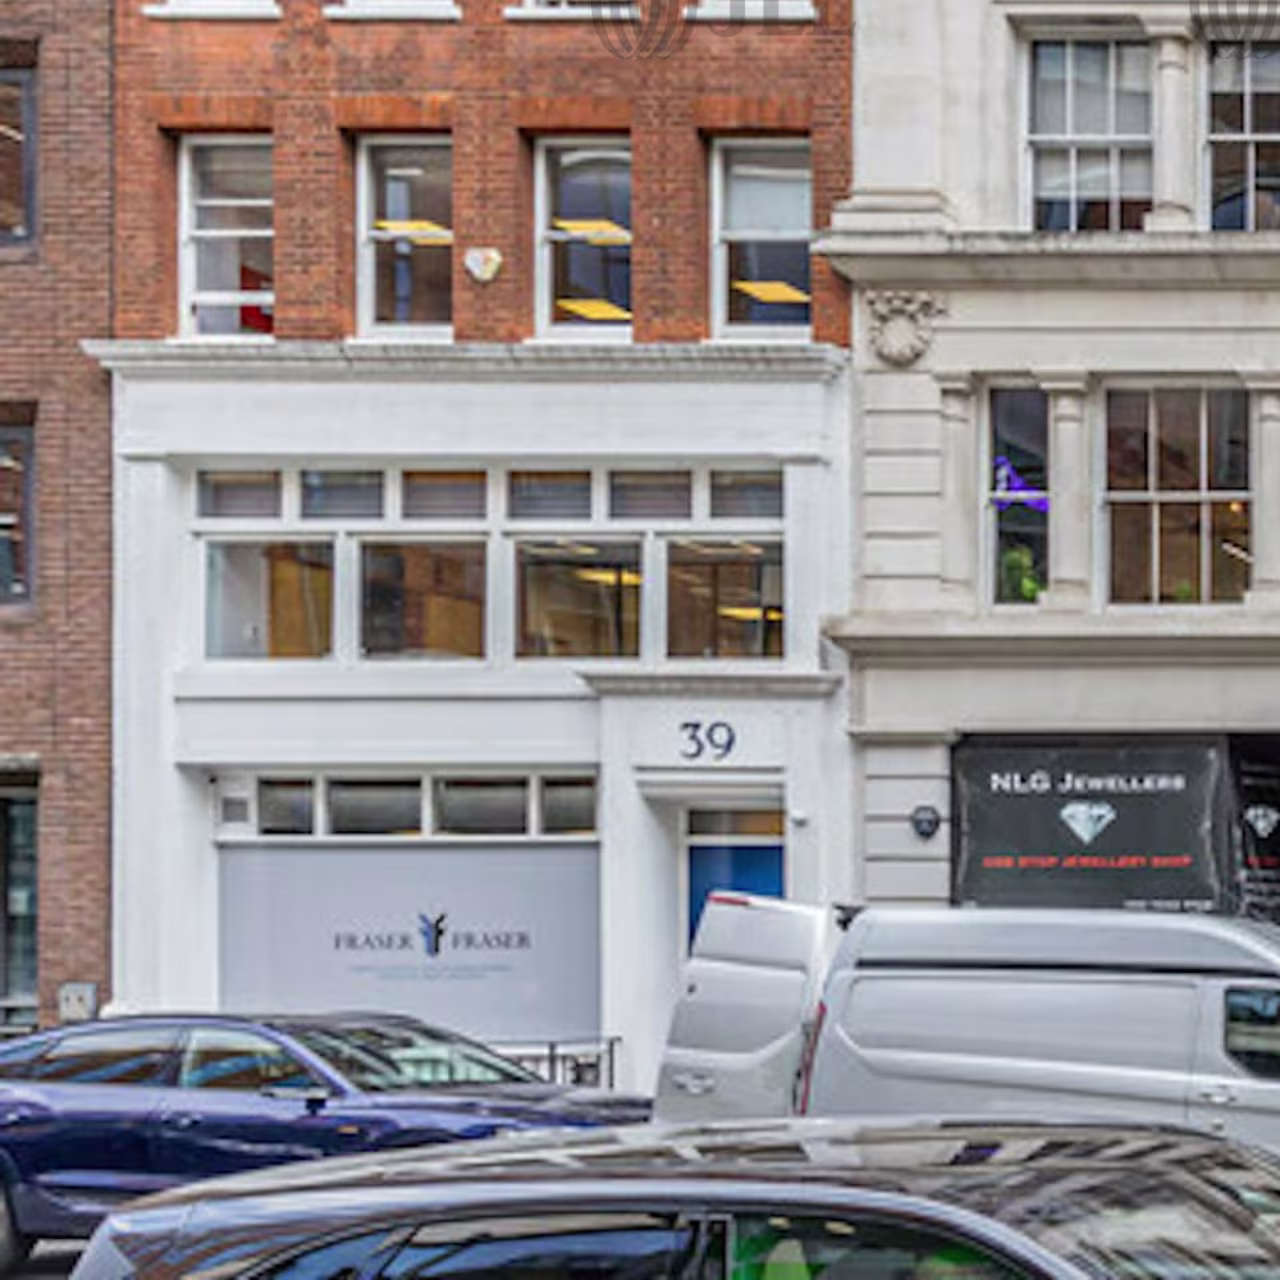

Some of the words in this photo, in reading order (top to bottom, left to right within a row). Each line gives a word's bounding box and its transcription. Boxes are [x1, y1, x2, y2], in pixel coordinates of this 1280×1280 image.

[679, 721, 736, 761] 39
[990, 771, 1050, 792] NLG
[333, 932, 413, 951] FRASER
[452, 932, 533, 951] FRASER
